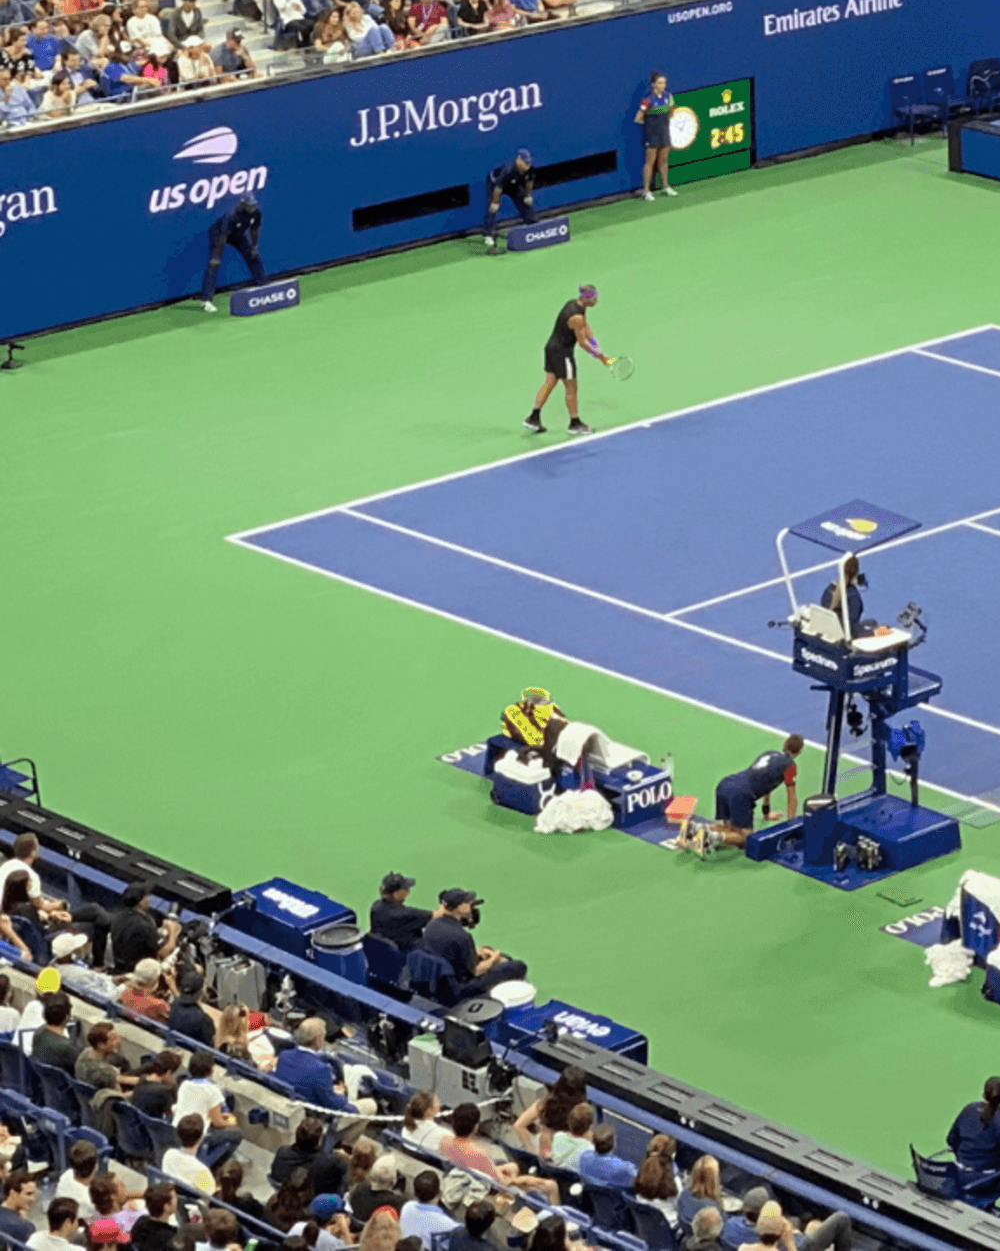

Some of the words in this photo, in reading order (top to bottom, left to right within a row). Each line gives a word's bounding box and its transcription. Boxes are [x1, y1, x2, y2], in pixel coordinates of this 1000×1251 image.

[667, 1, 734, 24] USOPEN.ORG
[763, 4, 841, 36] Emirates
[350, 82, 544, 147] J.P.Morgan
[708, 100, 745, 118] ROLEX
[149, 183, 187, 214] us
[189, 165, 268, 210] open
[525, 227, 558, 243] CHASE
[248, 291, 286, 308] CHASE
[626, 780, 673, 814] POLO
